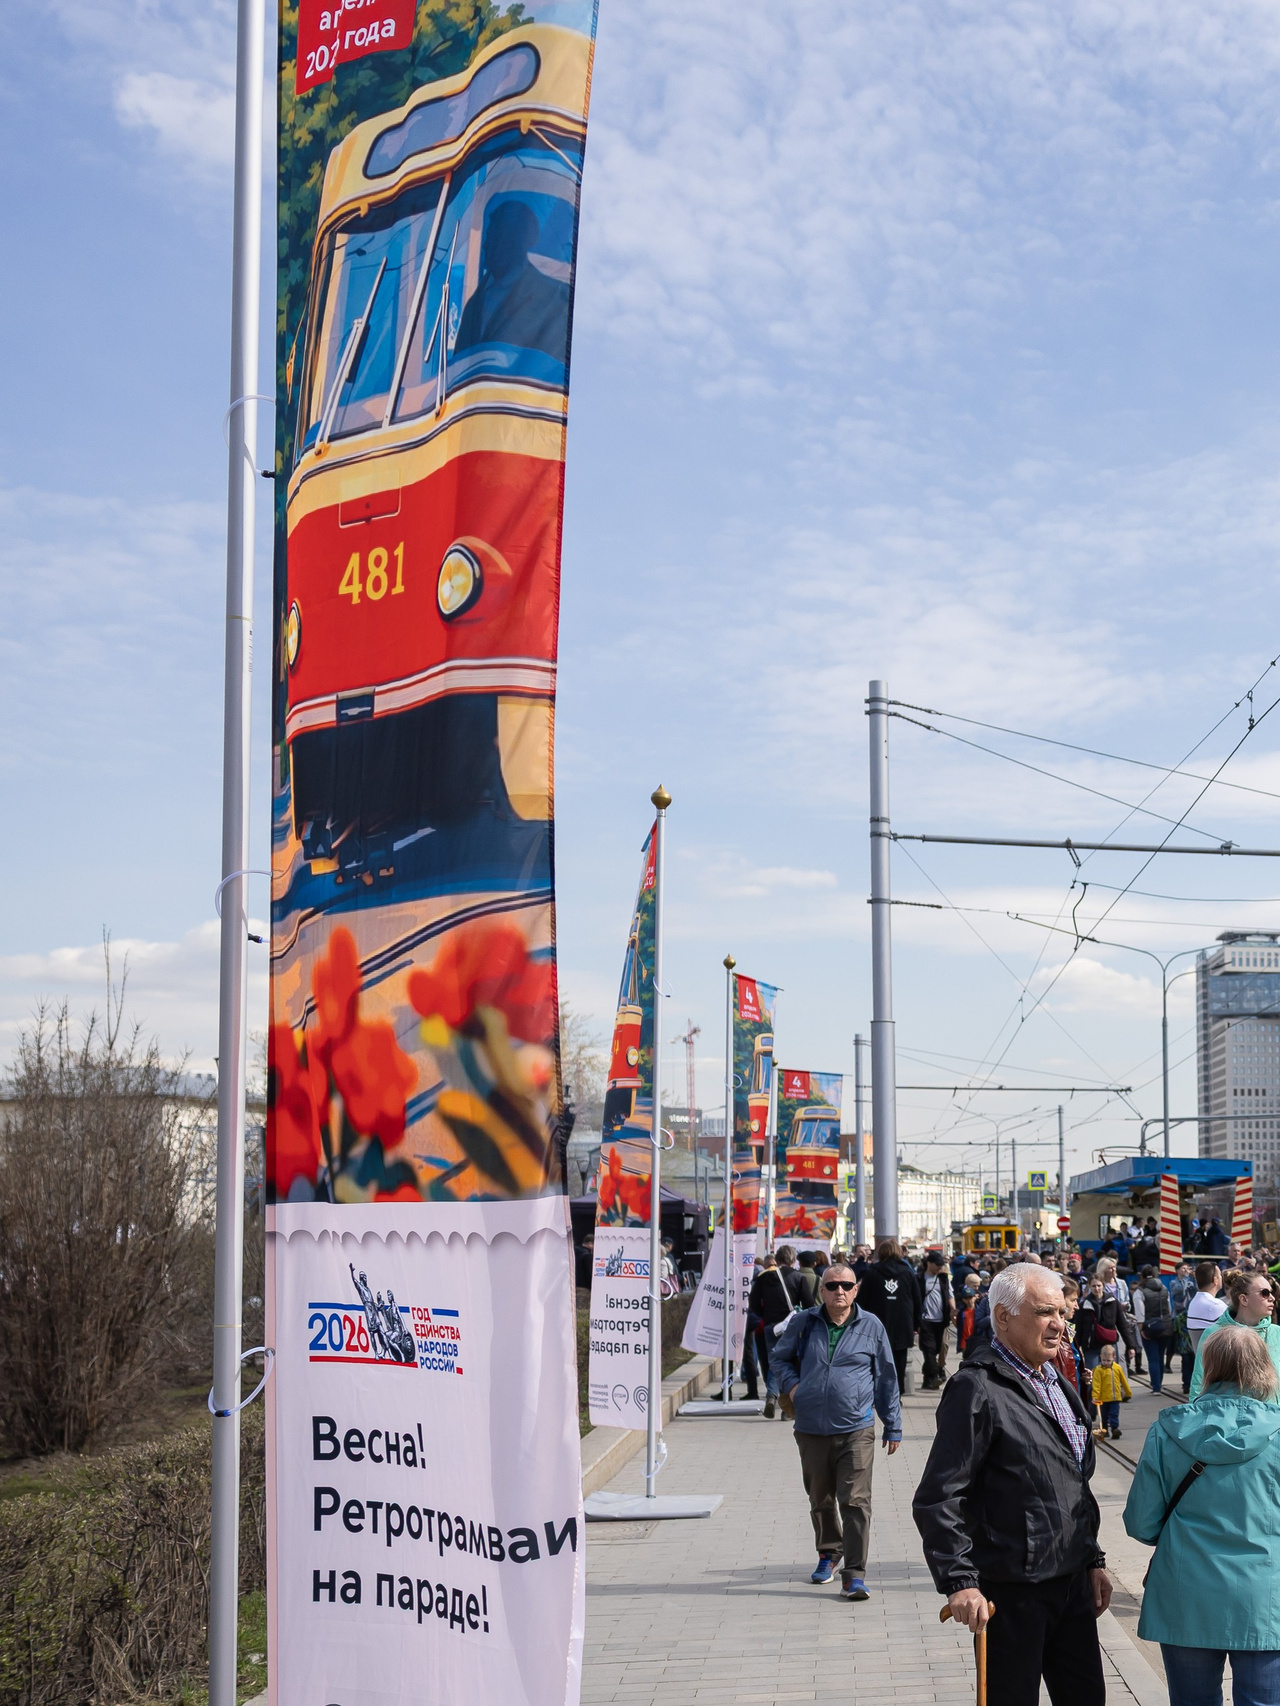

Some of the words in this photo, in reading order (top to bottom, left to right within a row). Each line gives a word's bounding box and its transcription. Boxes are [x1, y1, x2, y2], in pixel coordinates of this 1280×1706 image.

[344, 18, 396, 49] года
[338, 541, 405, 605] 481
[745, 986, 753, 1004] 4
[792, 1075, 802, 1088] 4
[411, 1307, 431, 1323] ГОД
[308, 1313, 370, 1353] 2026
[414, 1324, 461, 1341] ЕДИНСТВА
[417, 1340, 459, 1357] НАРОДОВ
[419, 1356, 455, 1374] РОССИИ
[312, 1416, 426, 1469] Весна!
[313, 1486, 578, 1564] Ретротрамваи
[312, 1569, 362, 1604] на
[376, 1572, 490, 1634] параде!
